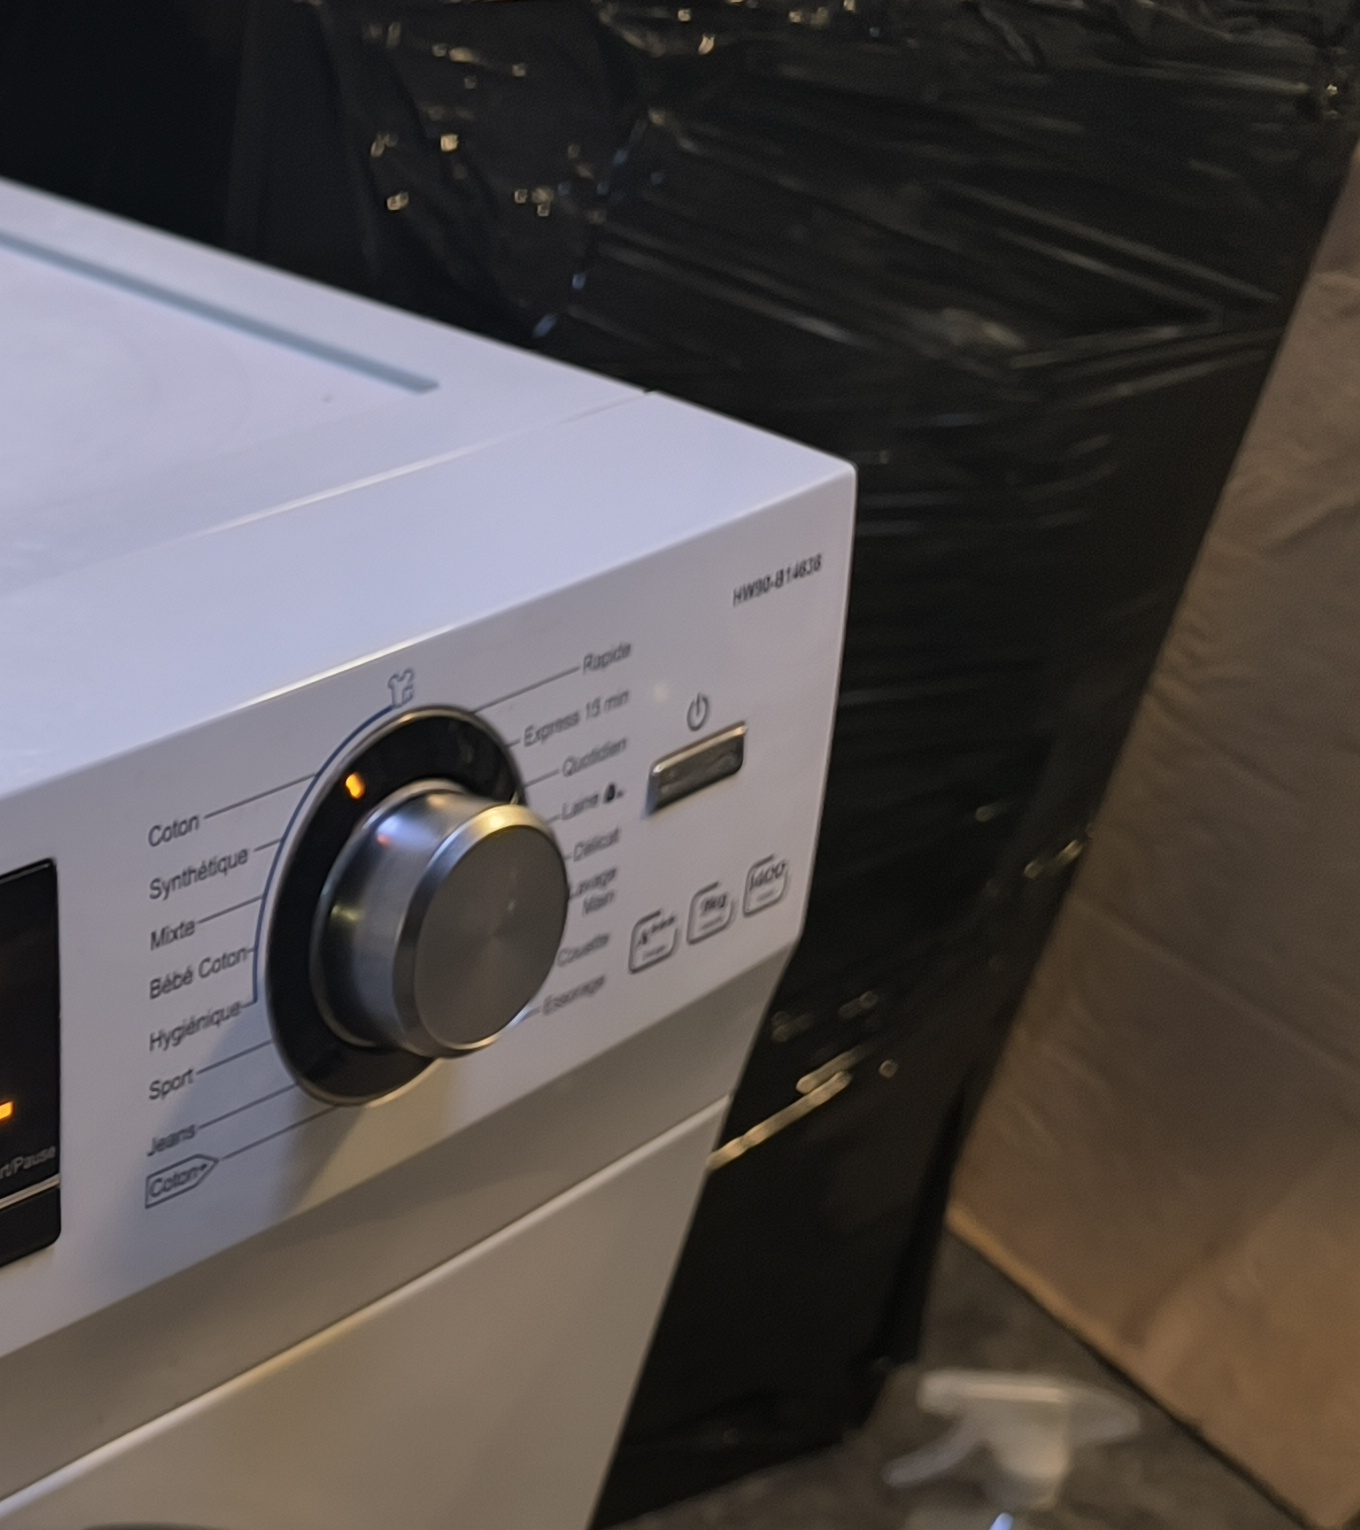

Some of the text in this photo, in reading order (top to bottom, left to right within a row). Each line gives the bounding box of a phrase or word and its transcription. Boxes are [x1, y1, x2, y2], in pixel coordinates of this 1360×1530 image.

[583, 642, 631, 674] Rapide
[524, 690, 629, 747] Express 15 min
[562, 738, 627, 777] Quotidien
[148, 815, 199, 847] Coton
[149, 848, 249, 900] Synthétique
[150, 920, 196, 950] Mixte
[150, 948, 247, 1000] Bébé Coton
[149, 1001, 241, 1050] Hygiénique
[149, 1068, 194, 1100] Sport
[147, 1124, 196, 1157] Jeans
